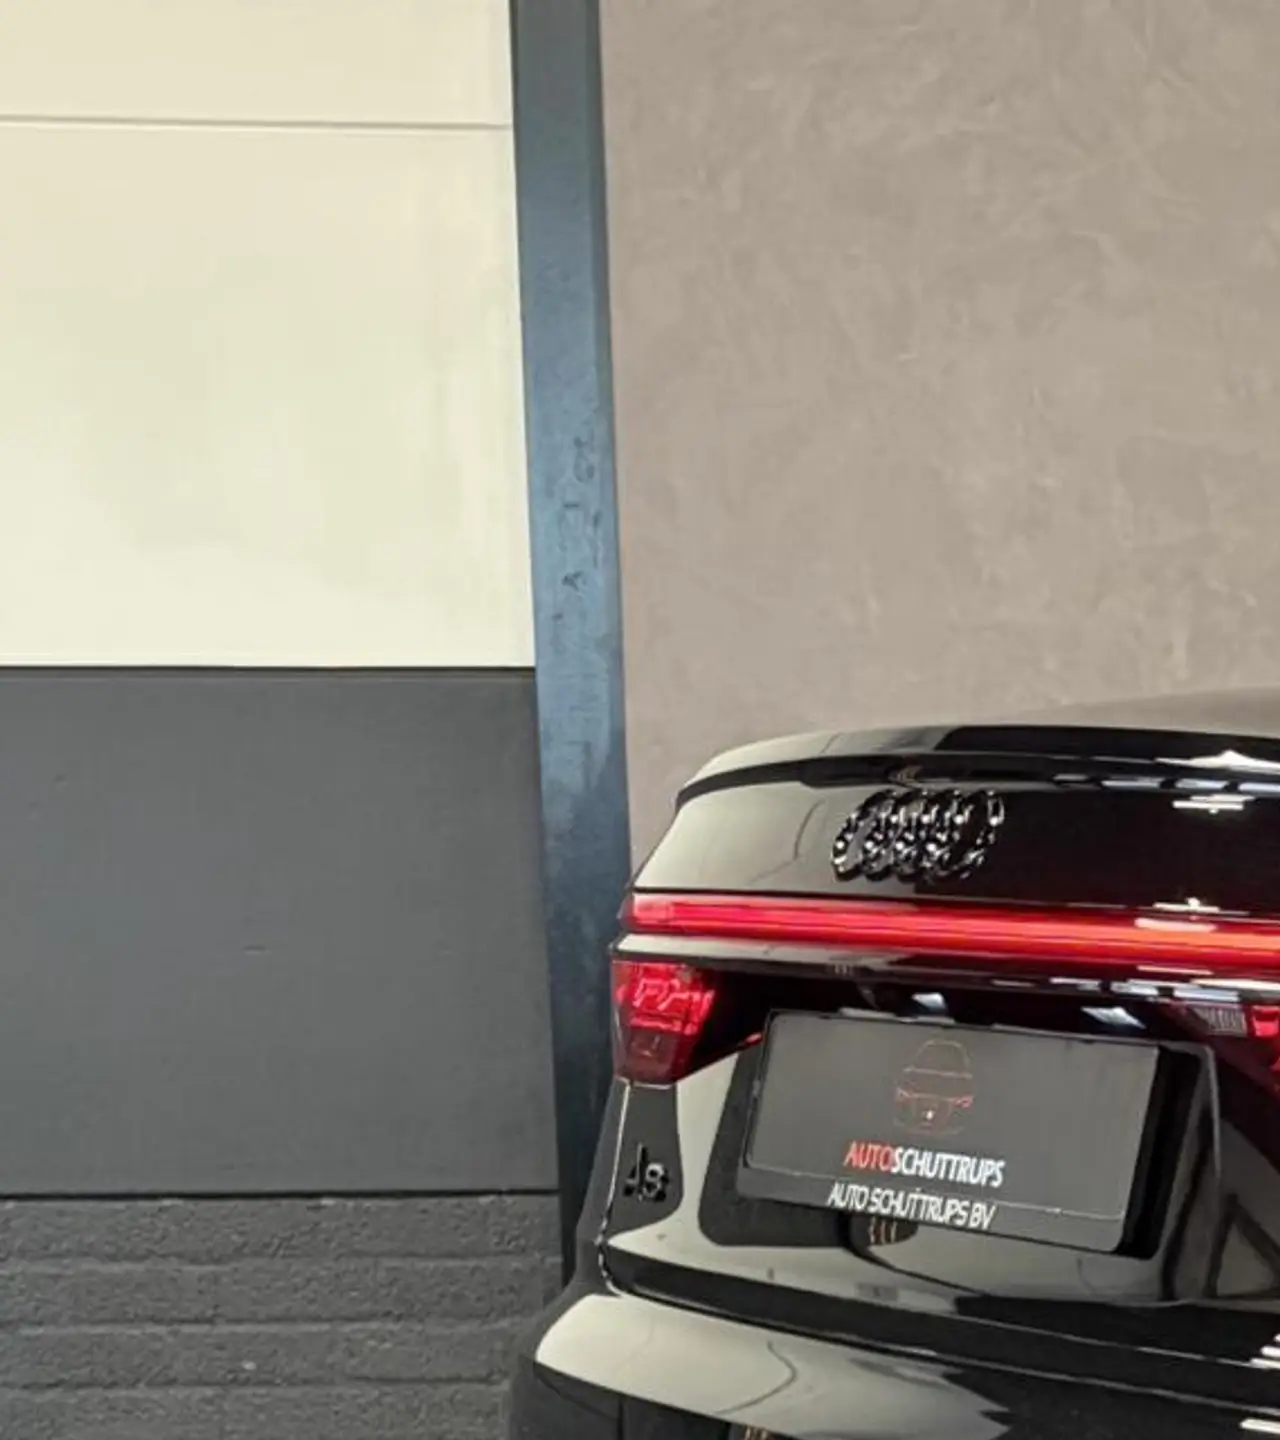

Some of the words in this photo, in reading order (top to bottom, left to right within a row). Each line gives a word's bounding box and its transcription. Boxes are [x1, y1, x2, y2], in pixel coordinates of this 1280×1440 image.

[843, 1139, 1006, 1188] AUTOSCHUTTRUPS
[827, 1181, 870, 1210] AUTO
[867, 1186, 970, 1228] SCHUTTRUPS
[968, 1201, 997, 1231] BV
